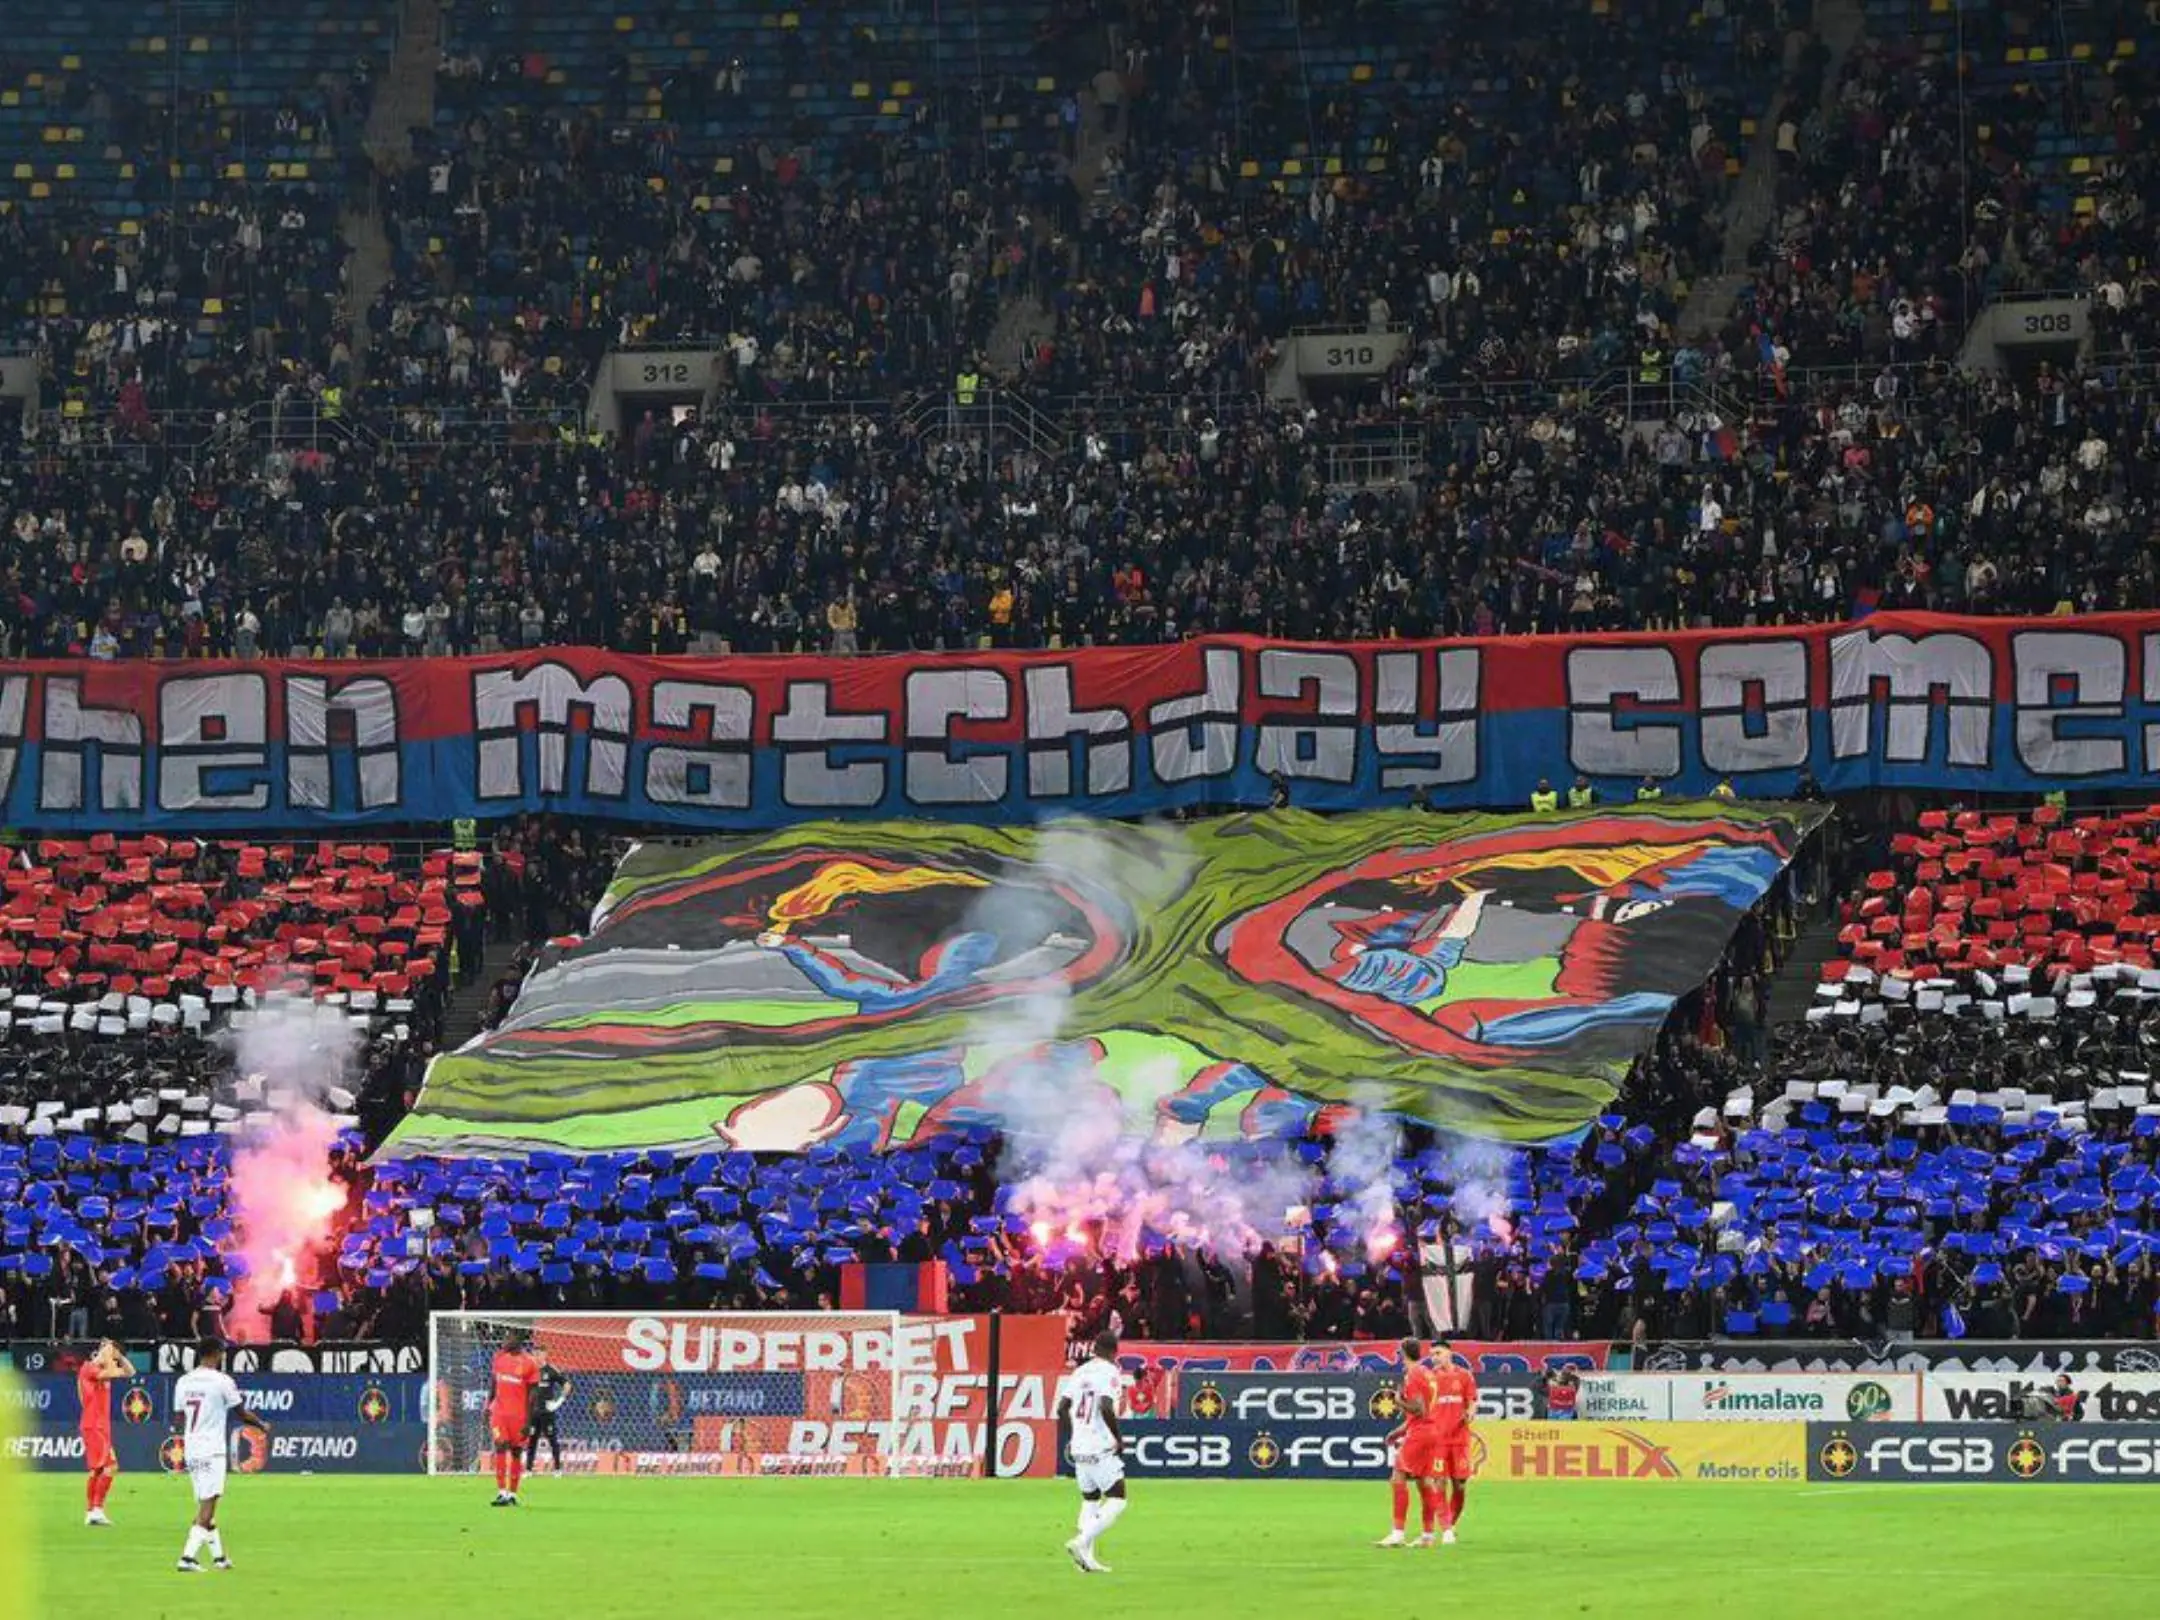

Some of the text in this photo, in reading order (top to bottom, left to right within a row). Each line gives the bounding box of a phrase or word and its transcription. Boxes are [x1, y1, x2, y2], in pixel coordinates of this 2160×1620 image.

[2024, 314, 2072, 334] 308
[1327, 347, 1374, 366] 310
[643, 365, 688, 382] 312
[470, 643, 1484, 811] matchday
[1567, 628, 2160, 778] come
[1586, 1381, 1616, 1393] THE
[1704, 1381, 1824, 1411] Himalaya
[186, 1399, 202, 1433] 7
[1233, 1386, 1356, 1420] FCSB
[1475, 1387, 1535, 1420] SB
[1586, 1398, 1649, 1411] HERBAL
[271, 1436, 358, 1458] BETANO
[1510, 1440, 1682, 1478] HELIX
[1864, 1437, 1995, 1474] FCSB
[1697, 1458, 1800, 1479] Motor oils
